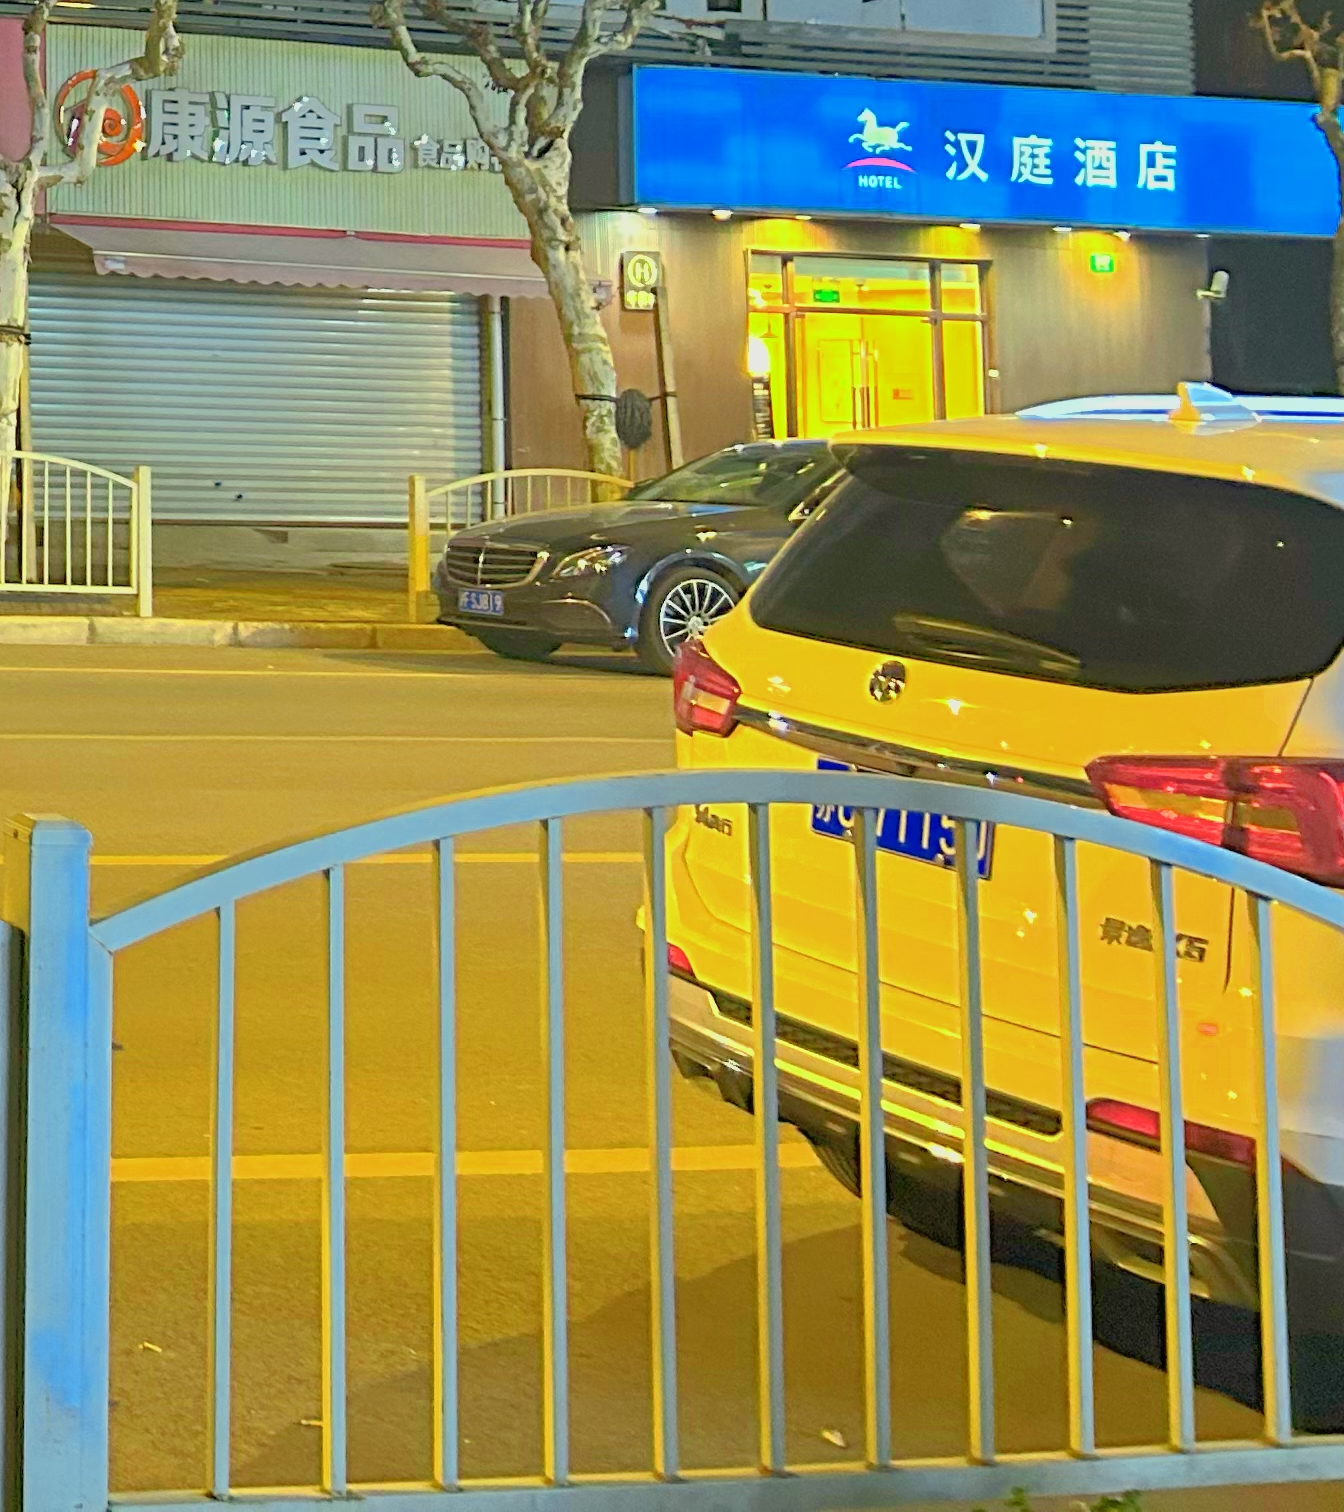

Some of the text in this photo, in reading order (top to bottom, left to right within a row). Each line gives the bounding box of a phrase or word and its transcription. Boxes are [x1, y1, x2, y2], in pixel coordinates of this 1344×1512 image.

[147, 88, 405, 174] 康源食品
[944, 129, 1178, 192] 汉庭酒店
[857, 174, 904, 189] HOTEL
